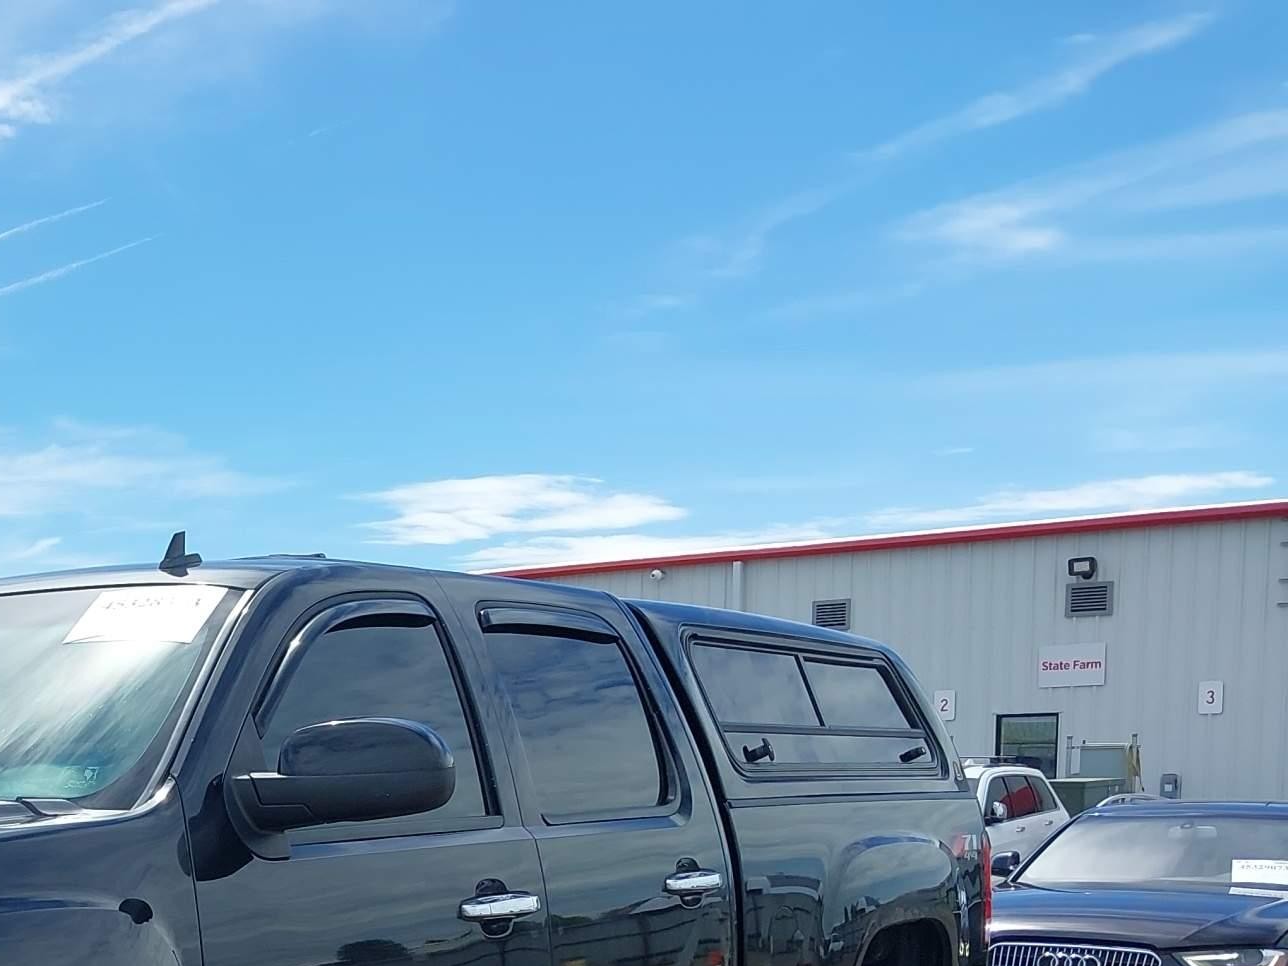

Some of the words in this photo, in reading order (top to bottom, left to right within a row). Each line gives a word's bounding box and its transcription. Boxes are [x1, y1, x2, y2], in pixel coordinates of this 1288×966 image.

[1041, 660, 1071, 672] State
[1072, 659, 1102, 671] Farm
[1206, 690, 1215, 705] 3
[940, 698, 949, 712] 2
